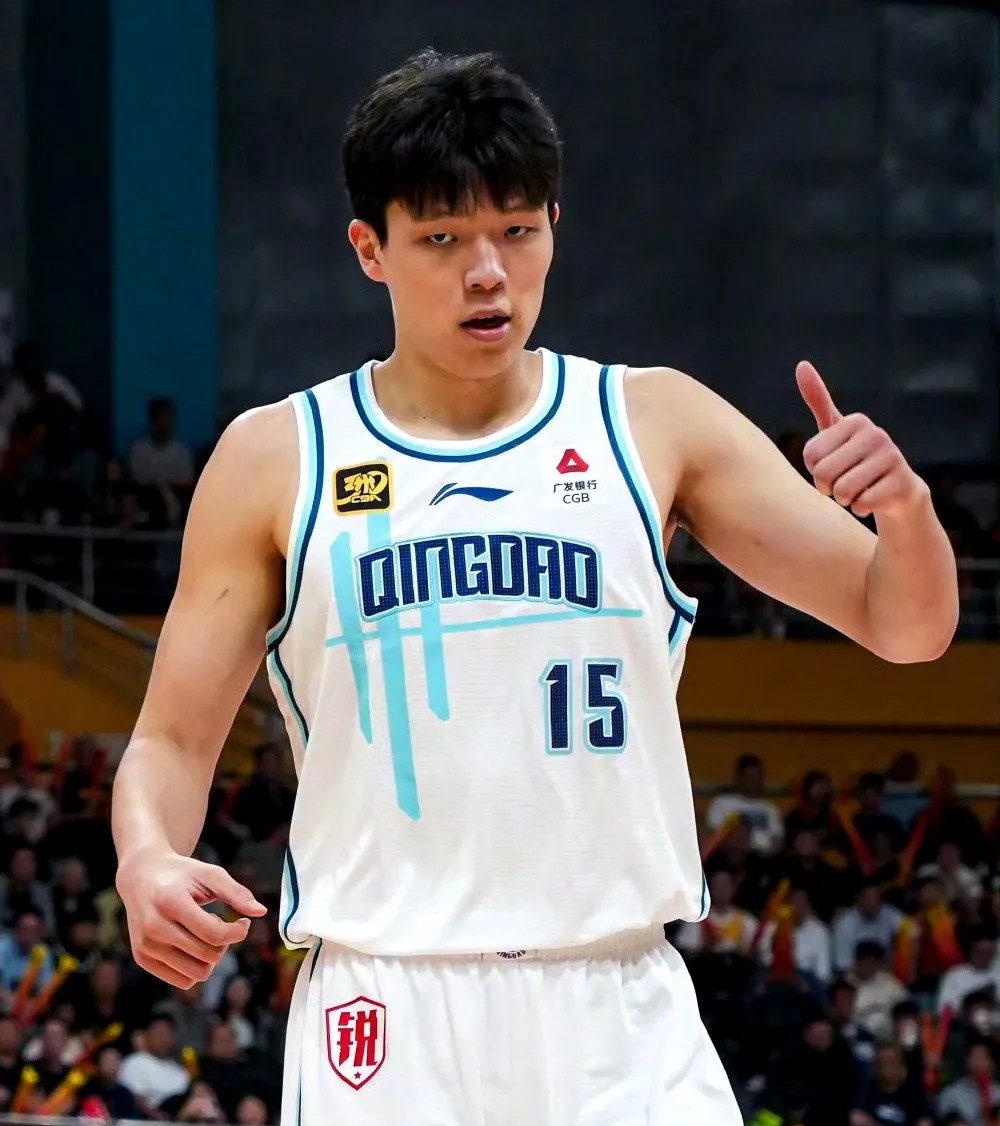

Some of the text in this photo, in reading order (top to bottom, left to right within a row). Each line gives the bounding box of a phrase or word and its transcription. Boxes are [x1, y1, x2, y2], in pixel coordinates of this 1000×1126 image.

[553, 480, 597, 493] 广发银行
[351, 494, 382, 503] CBA
[563, 493, 590, 504] CGB
[356, 532, 601, 620] QINGDAO
[543, 661, 627, 752] 15
